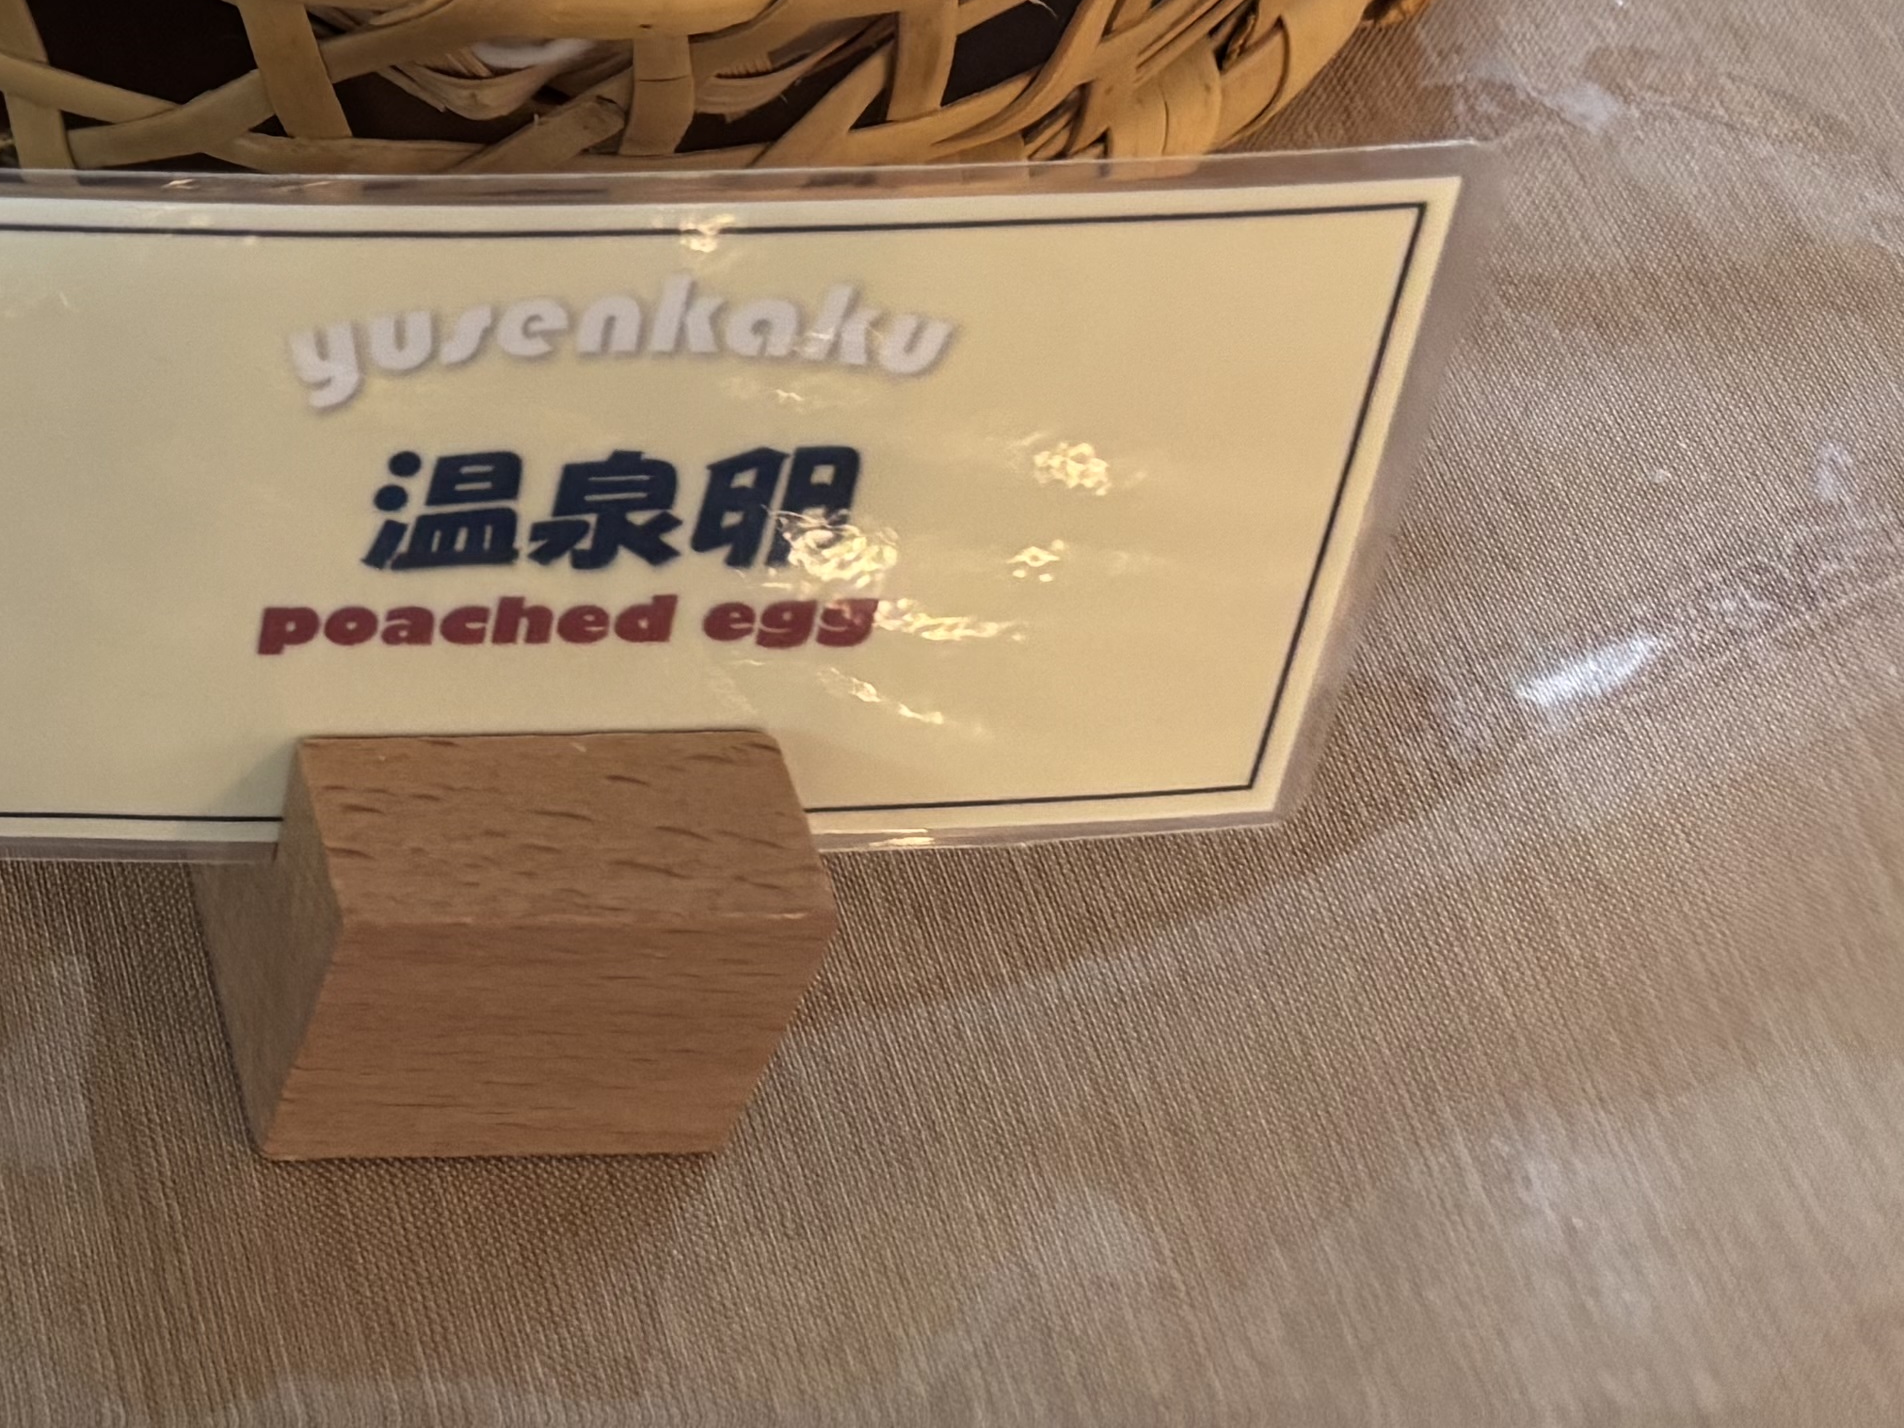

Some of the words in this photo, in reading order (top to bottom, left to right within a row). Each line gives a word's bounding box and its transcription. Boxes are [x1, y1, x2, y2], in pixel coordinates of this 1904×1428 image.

[289, 274, 957, 411] yusenkaku
[360, 445, 862, 571] 温泉卵
[257, 594, 679, 655] poached
[703, 597, 880, 650] egg
